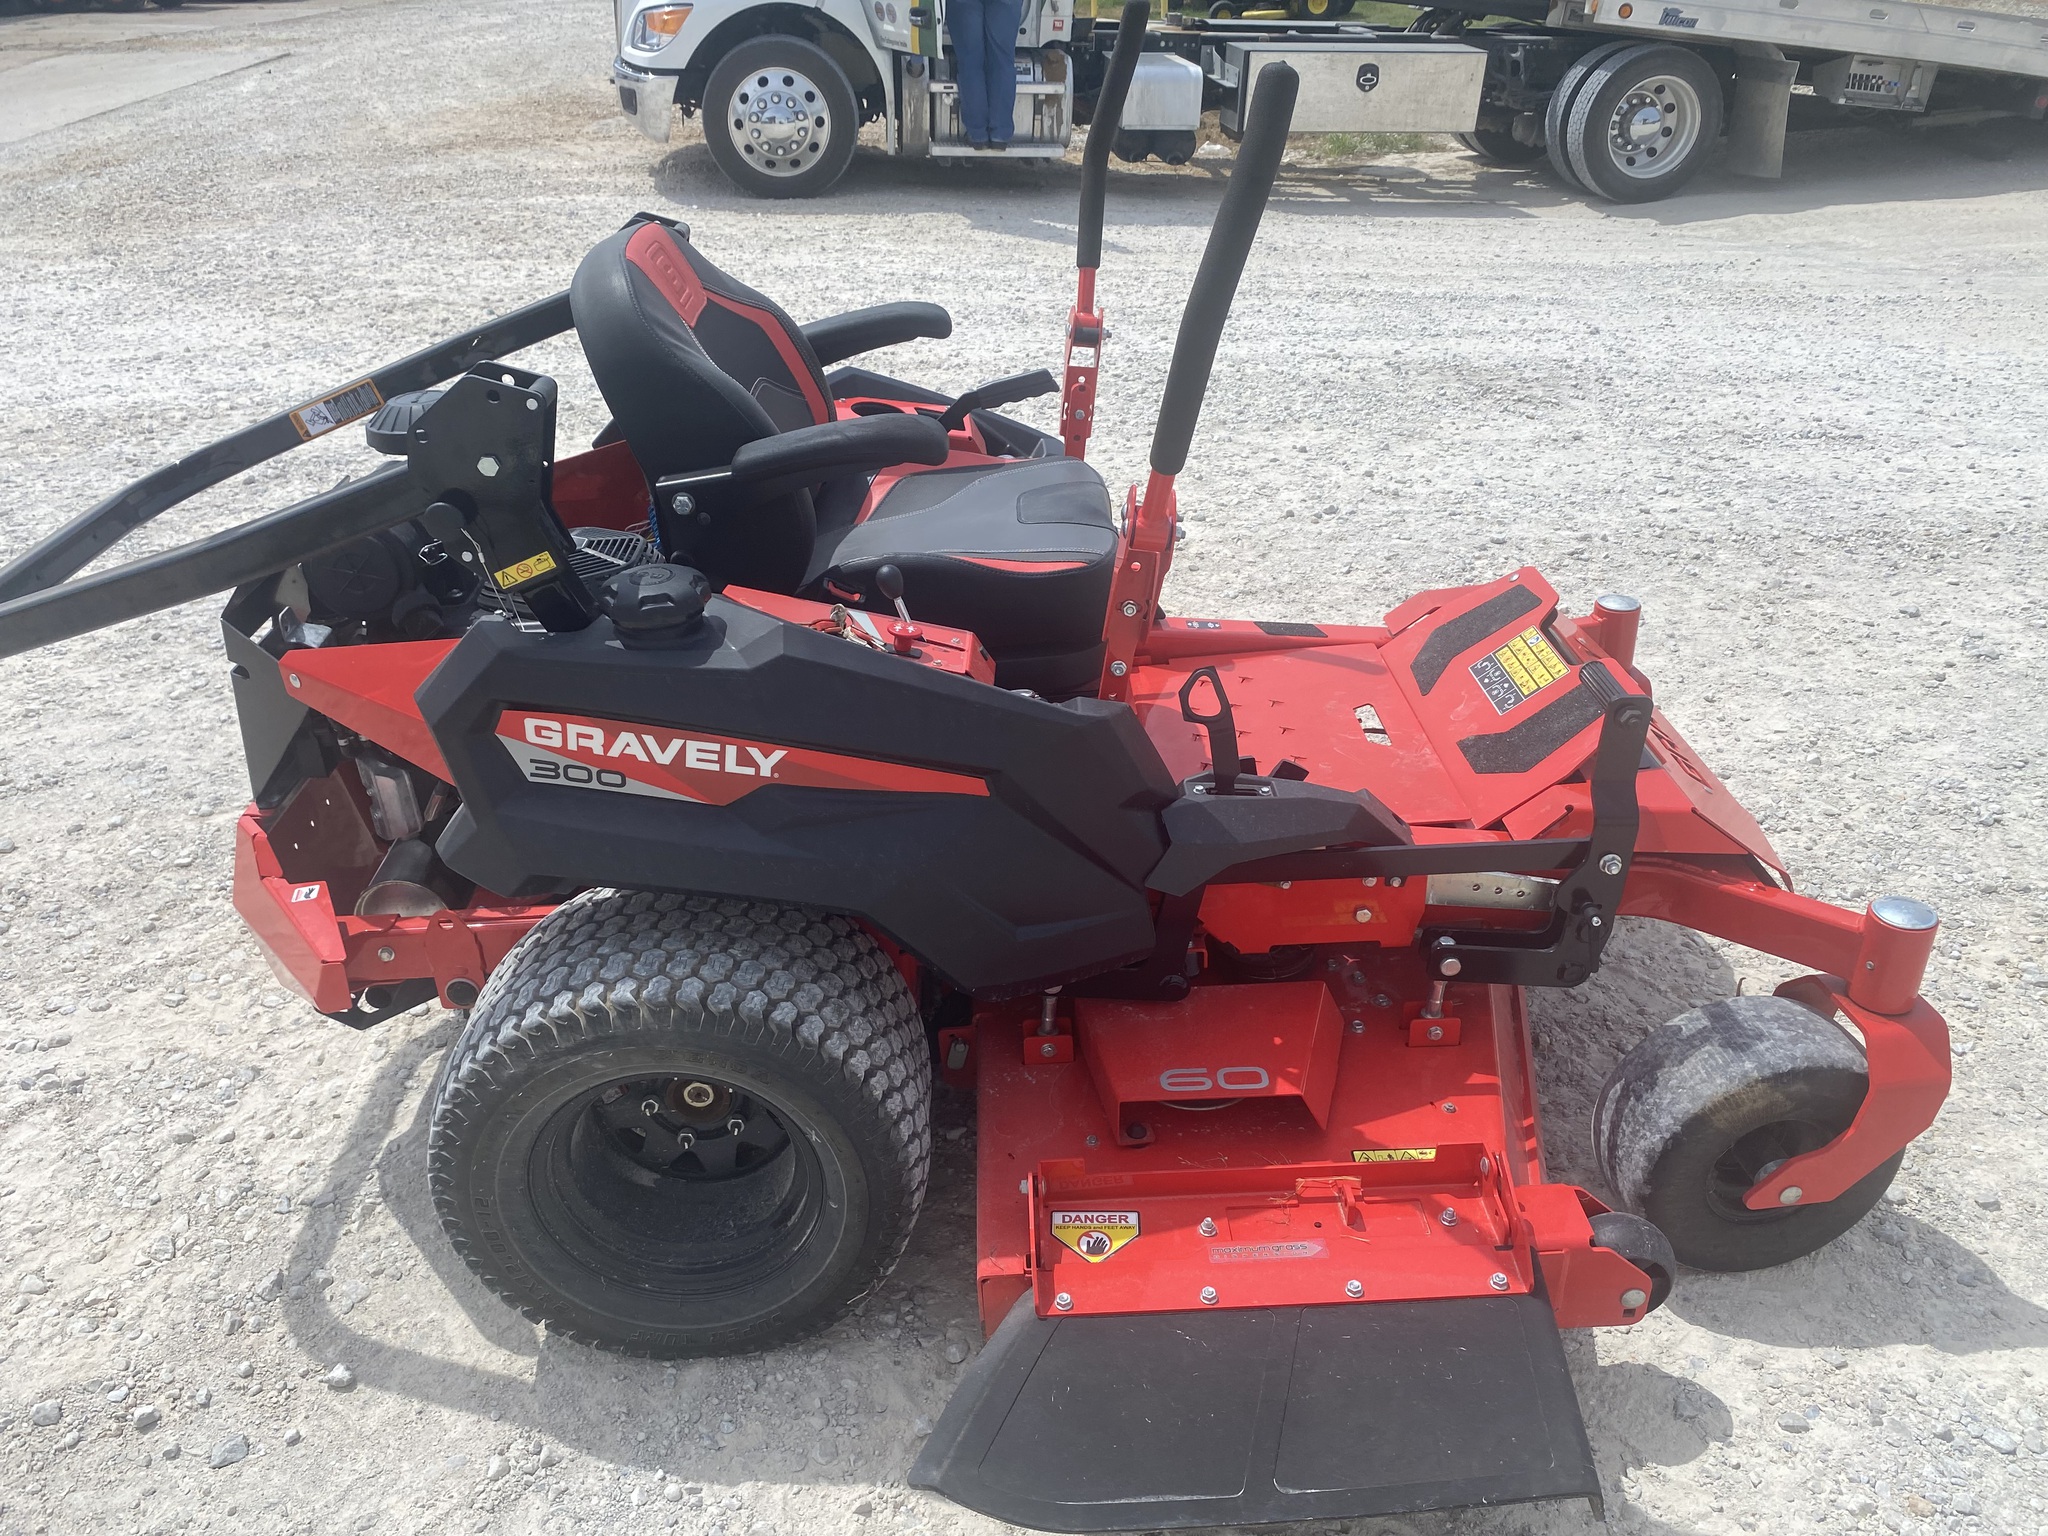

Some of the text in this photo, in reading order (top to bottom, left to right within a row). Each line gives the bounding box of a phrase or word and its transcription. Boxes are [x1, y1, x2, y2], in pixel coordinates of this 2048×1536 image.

[523, 717, 788, 777] GRAVELY
[529, 758, 627, 789] 300
[1160, 1066, 1269, 1092] 60
[1062, 1214, 1130, 1224] DANGER
[1211, 1243, 1308, 1254] maximum grass
